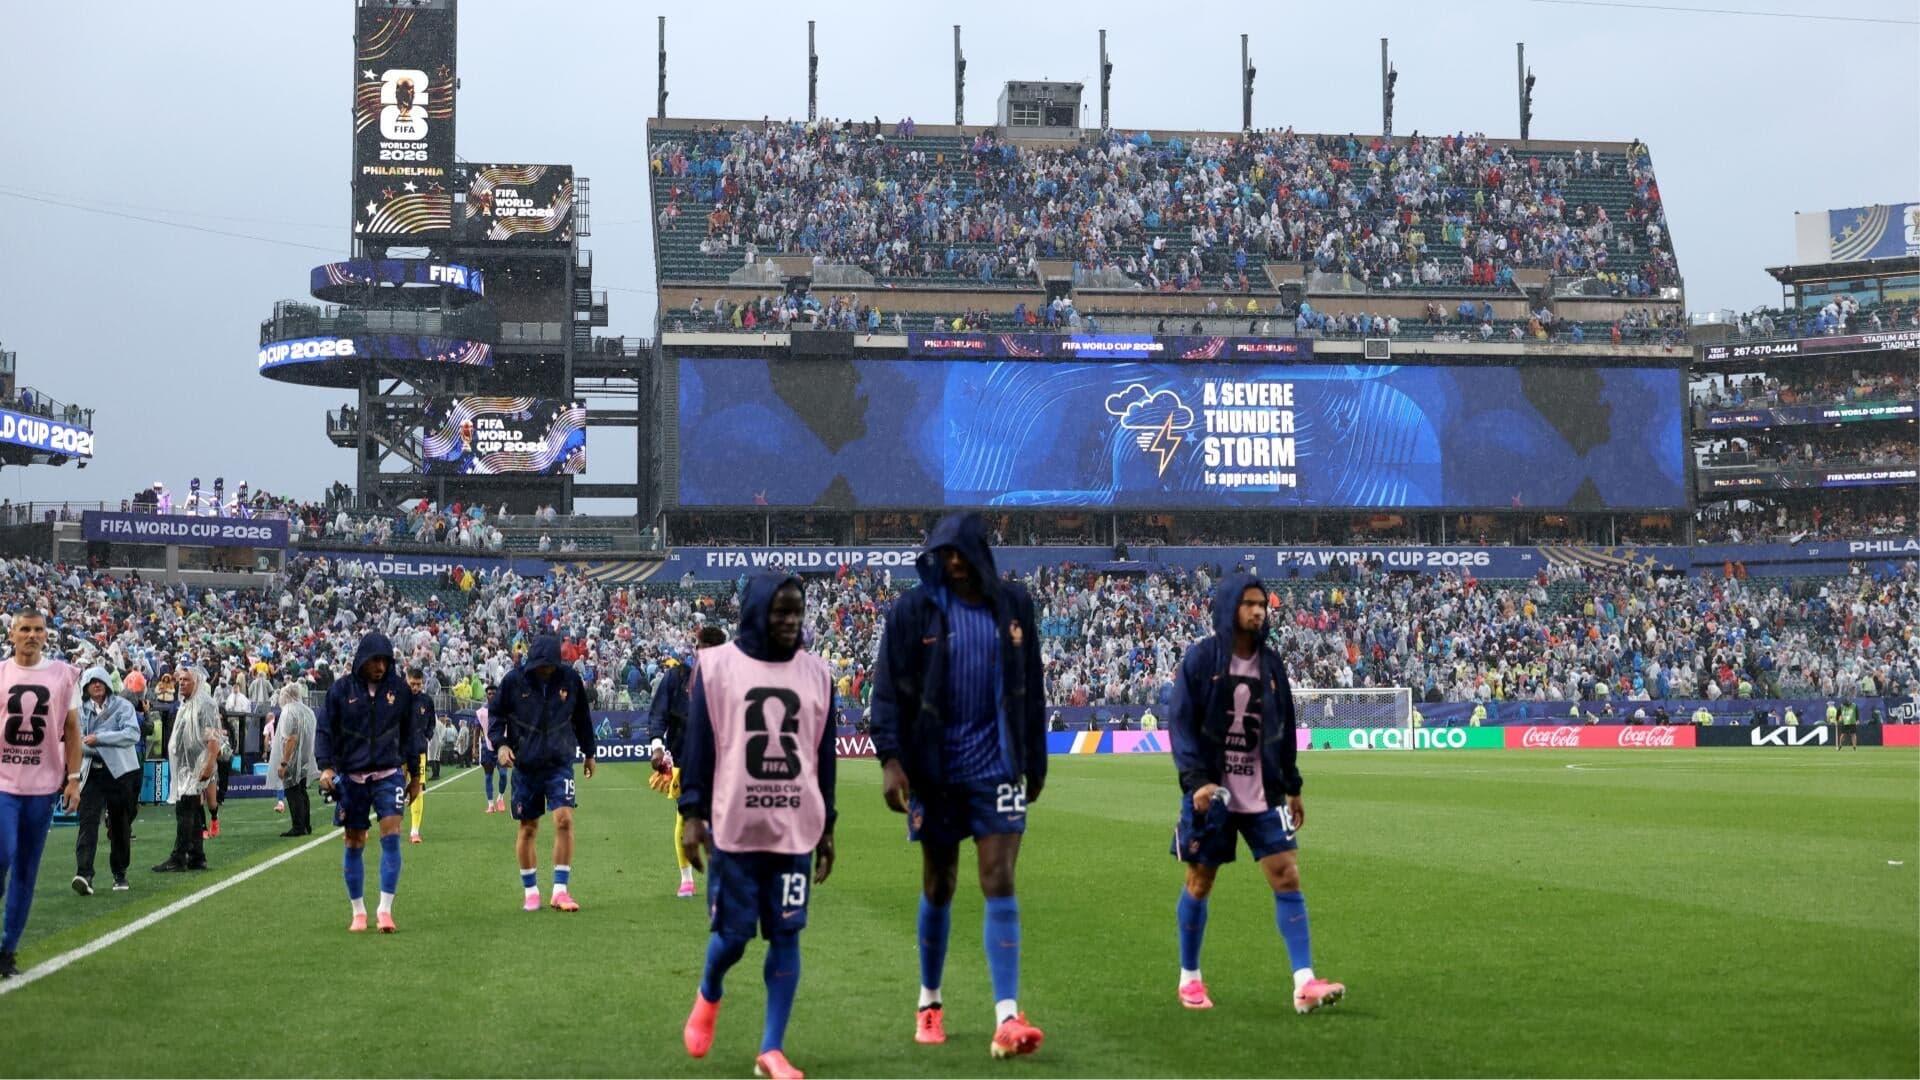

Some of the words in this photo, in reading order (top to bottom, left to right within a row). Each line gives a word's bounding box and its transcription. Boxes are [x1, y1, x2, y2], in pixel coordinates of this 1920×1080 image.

[394, 125, 415, 133] FIFA
[380, 141, 410, 150] WORLD
[411, 142, 428, 150] CUP
[380, 150, 428, 160] 2026
[362, 166, 444, 176] PHILADELPHIA
[495, 189, 518, 198] FIFA
[495, 198, 534, 207] WORLD
[495, 207, 516, 217] CUP
[517, 208, 555, 217] 2026
[430, 265, 465, 285] FIFA
[924, 339, 986, 348] PHILADELPHIA
[1862, 334, 1897, 344] STADIUM
[267, 344, 290, 364] CUP
[290, 338, 355, 360] 2026
[1062, 341, 1082, 351] FIFA
[1083, 342, 1113, 351] WORLD
[1114, 342, 1132, 351] CUP
[1237, 343, 1298, 353] PHILADELPHIA
[1733, 343, 1799, 357] 267-570-4444
[1880, 341, 1916, 351] STADIUM
[1203, 382, 1218, 406] A
[1221, 382, 1294, 406] SEVERE
[1824, 410, 1840, 418] FIFA
[1841, 408, 1869, 416] WORLD
[477, 419, 504, 430] FIFA
[1203, 409, 1295, 433] THUNDER
[17, 419, 49, 446] CUP
[477, 430, 523, 441] WORLD
[477, 441, 502, 452] CUP
[503, 441, 547, 453] 2026
[1204, 437, 1296, 467] STORM
[1218, 470, 1297, 487] approaching
[1827, 474, 1843, 482] FIFA
[1844, 473, 1872, 481] WORLD
[1873, 472, 1889, 480] CUP
[100, 519, 133, 535] FIFA
[135, 521, 189, 537] WORLD
[191, 524, 221, 538] CUP
[222, 525, 273, 540] 2026
[706, 552, 748, 566] FIFA
[751, 552, 822, 567] WORLD
[825, 551, 863, 566] CUP
[867, 551, 922, 566] 202
[1388, 551, 1424, 566] CUP
[1427, 552, 1490, 566] 2026
[16, 733, 34, 741] FIFA
[1225, 735, 1246, 746] FIFA
[1349, 727, 1467, 748] aramco
[1522, 726, 1580, 747] Coca-Cola
[1617, 726, 1675, 747] Coca-Cola
[3, 747, 28, 755] WORLD
[29, 748, 42, 756] CUP
[2, 755, 40, 765] 2026
[762, 761, 788, 773] FIFA
[1225, 763, 1254, 776] 026
[746, 785, 781, 793] WORLD
[745, 795, 801, 808] 2026
[997, 783, 1026, 812] 22
[781, 873, 806, 906] 13
